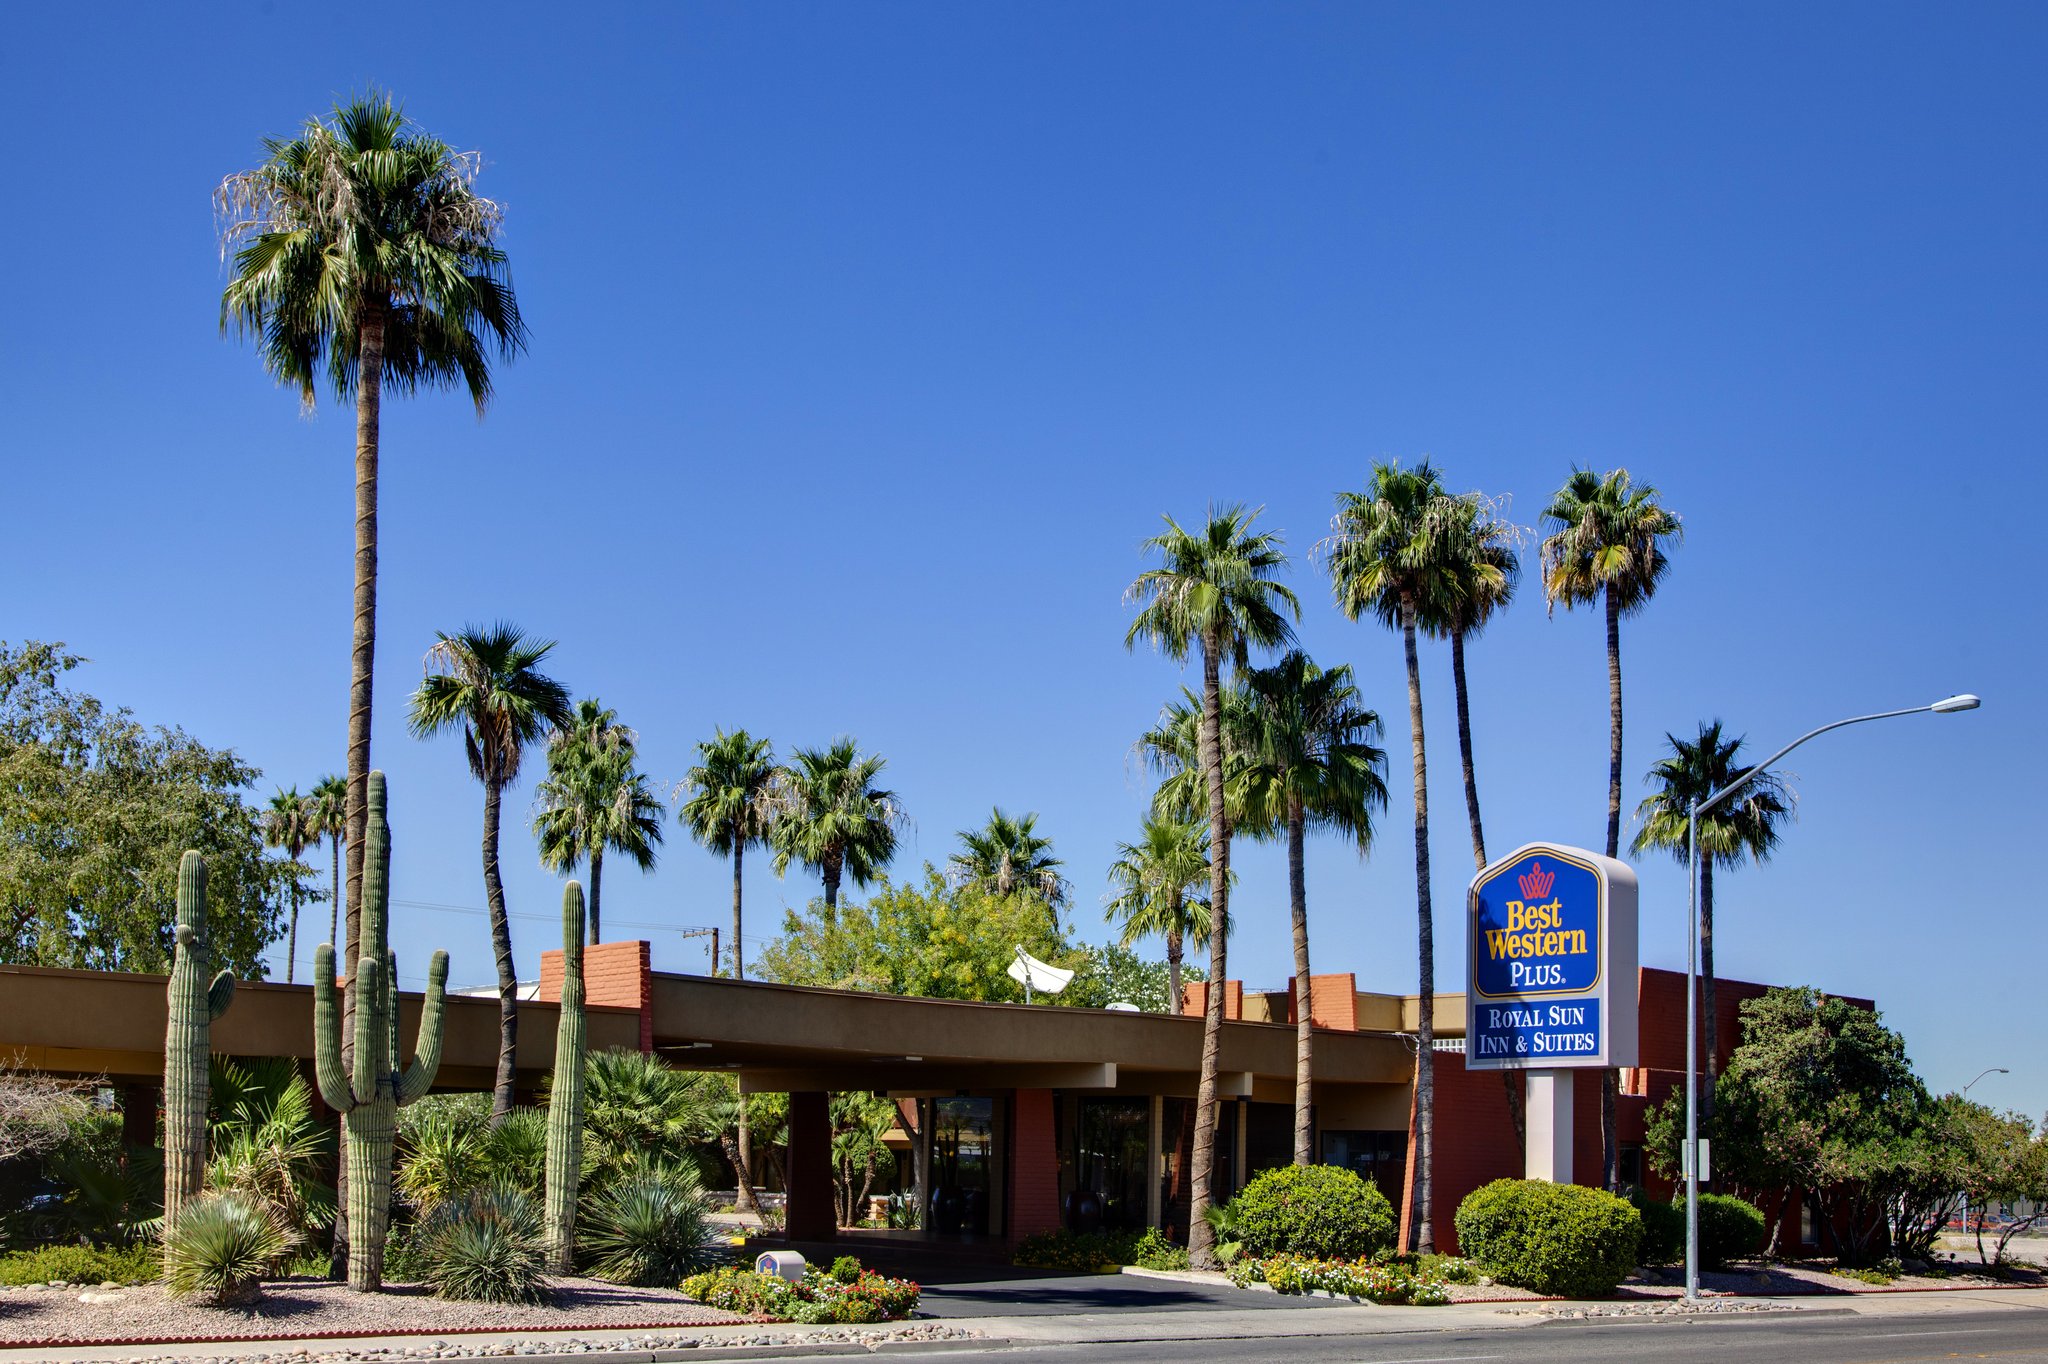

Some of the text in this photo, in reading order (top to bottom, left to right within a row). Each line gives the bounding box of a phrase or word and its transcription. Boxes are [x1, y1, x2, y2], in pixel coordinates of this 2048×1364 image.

[1506, 897, 1562, 931] Best
[1485, 928, 1587, 960] Western
[1489, 1006, 1584, 1029] ROYAL SUN
[1480, 1032, 1594, 1054] INN & SUITES
